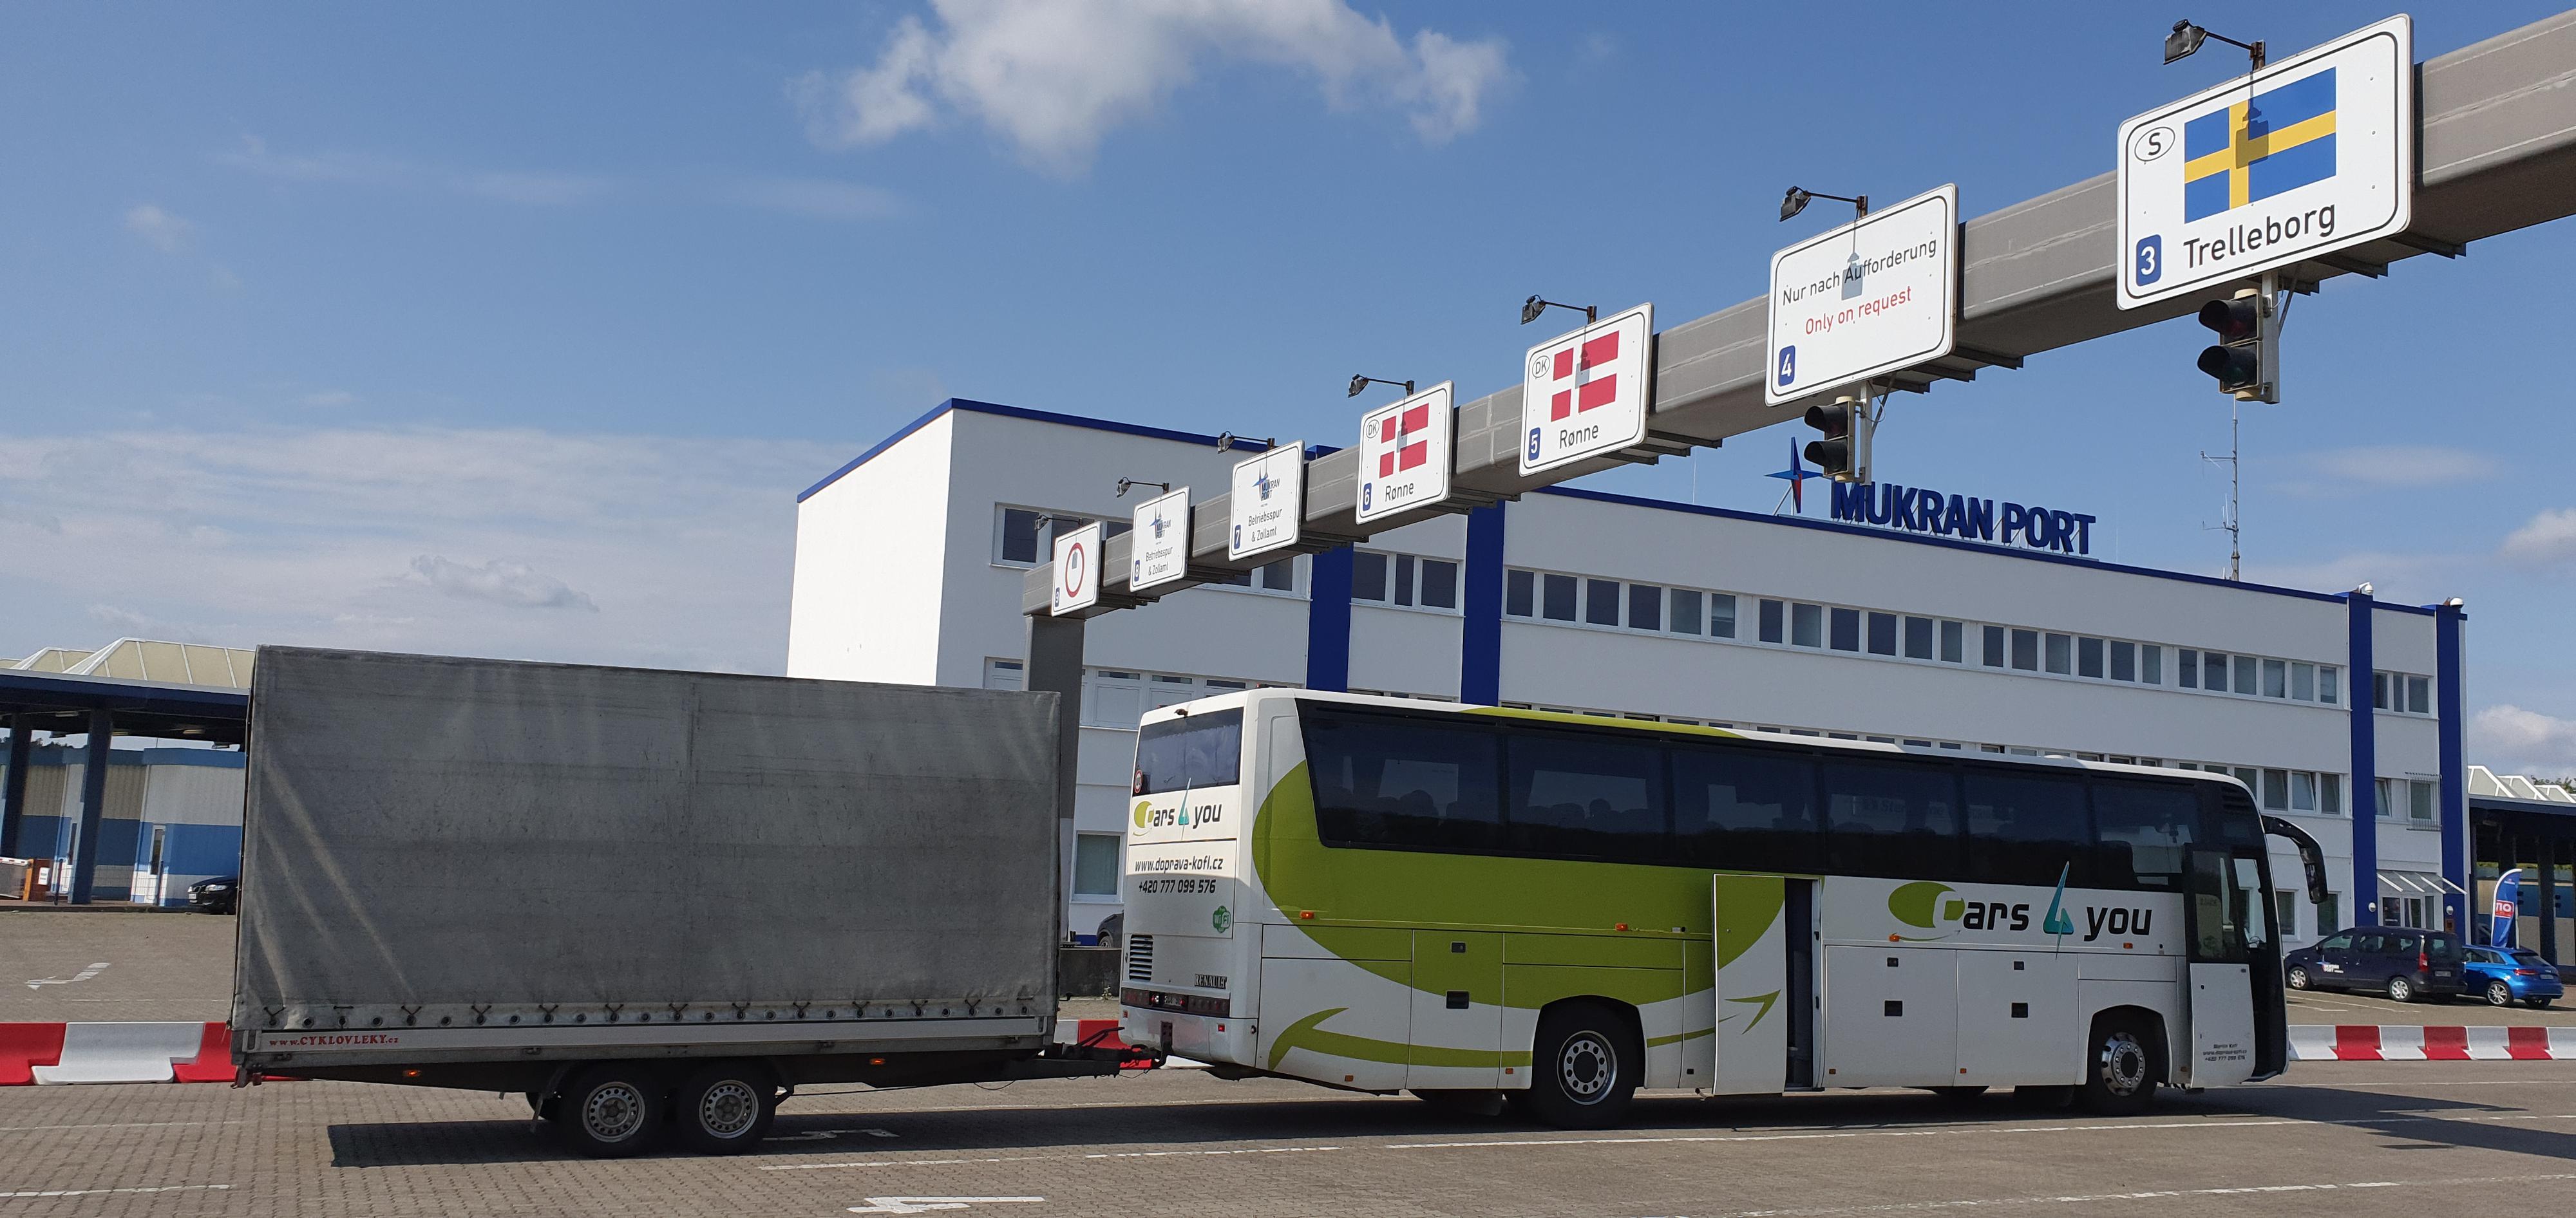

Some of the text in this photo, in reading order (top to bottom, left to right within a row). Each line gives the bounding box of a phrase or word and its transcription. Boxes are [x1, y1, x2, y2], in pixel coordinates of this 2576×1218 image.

[2148, 133, 2161, 156] S
[2183, 203, 2335, 268] Trelleborg
[2141, 246, 2155, 276] 3
[1783, 238, 1937, 306] Nur nach Aufforderung
[1805, 286, 1911, 337] Only on request
[1535, 359, 1547, 375] DK
[1781, 353, 1792, 377] 4
[1368, 423, 1377, 436] DK
[1559, 424, 1598, 450] Rønne
[1531, 434, 1538, 453] 5
[1262, 478, 1280, 491] MUKRAN
[1385, 482, 1414, 502] Rønne
[1261, 491, 1273, 501] PORT
[1364, 489, 1370, 505] 6
[1248, 509, 1282, 527] Betriebsspur
[1831, 481, 2096, 555] MUKRAN PORT
[1235, 530, 1239, 544] 7
[1251, 526, 1277, 542] & Zollamt
[1146, 547, 1173, 561] Betriebsspur
[1135, 565, 1139, 577] 8
[1193, 804, 1222, 829] you
[1135, 856, 1224, 874] www.doprava-kofl.cz
[1139, 879, 1216, 893] +420 777 099 576
[2084, 906, 2152, 941] you
[1195, 974, 1227, 989] RENAULT
[269, 1034, 399, 1047] www.CYKLOVLEKY.cz
